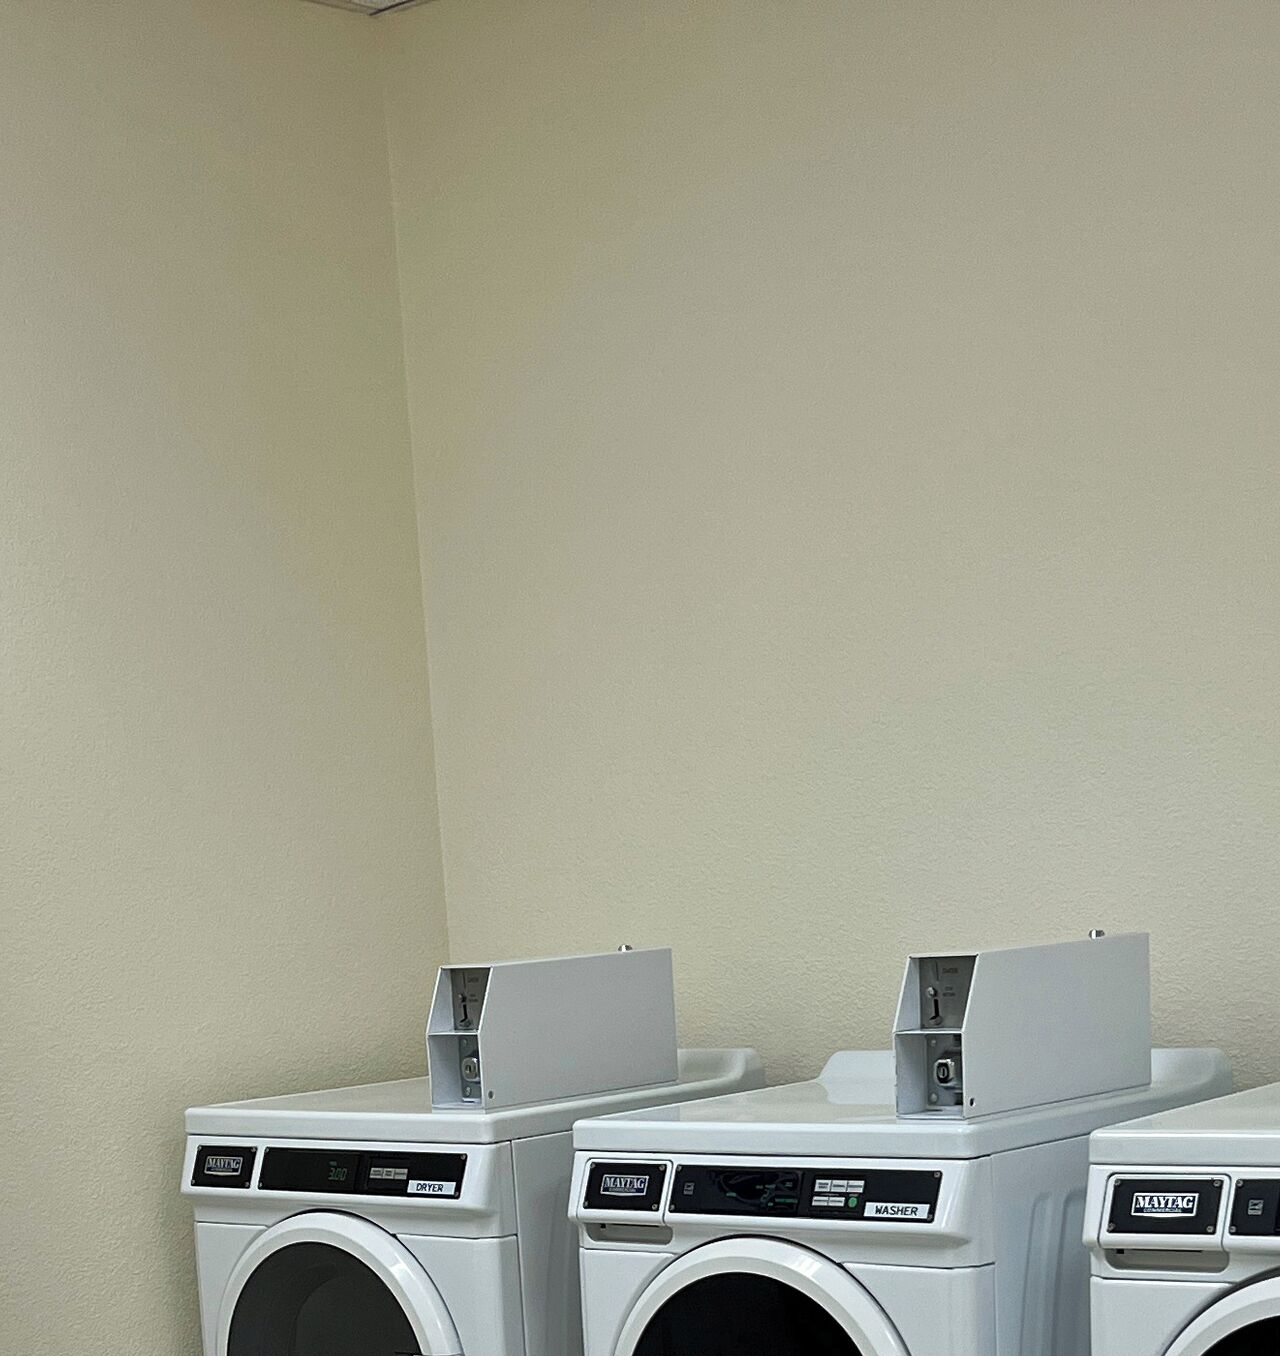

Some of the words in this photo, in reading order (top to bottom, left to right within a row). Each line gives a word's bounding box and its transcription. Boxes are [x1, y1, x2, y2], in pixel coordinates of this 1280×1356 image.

[207, 1158, 240, 1169] MAYTAG
[416, 1183, 444, 1192] DRYER
[604, 1177, 645, 1189] MAYTAG
[1135, 1196, 1194, 1208] MAYTAG
[875, 1205, 919, 1216] WASHER
